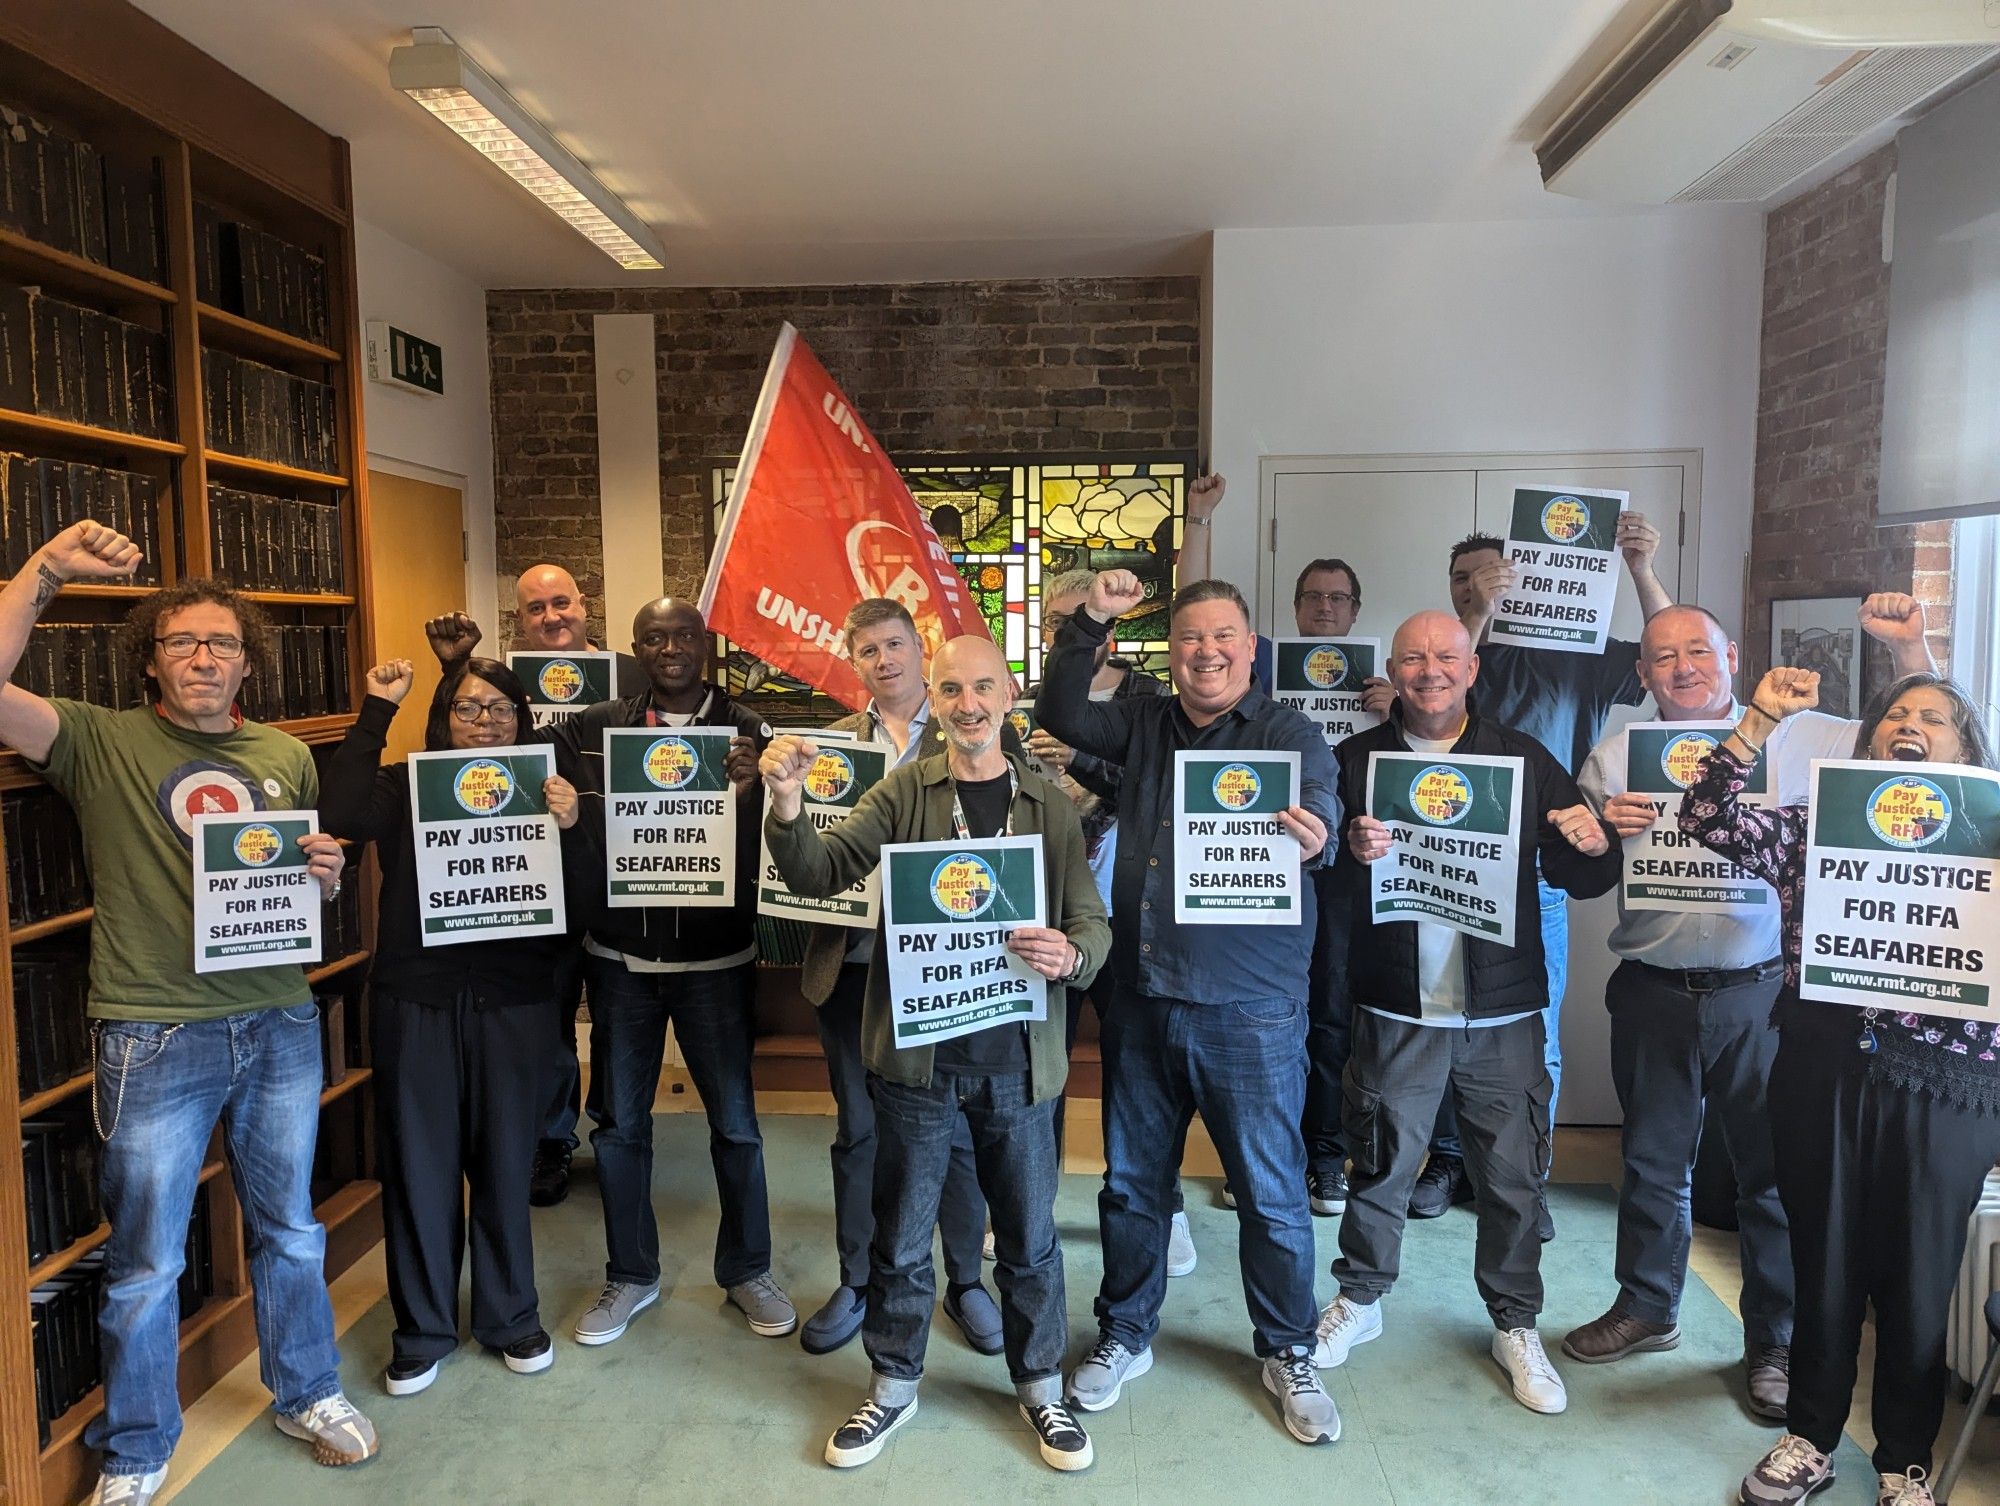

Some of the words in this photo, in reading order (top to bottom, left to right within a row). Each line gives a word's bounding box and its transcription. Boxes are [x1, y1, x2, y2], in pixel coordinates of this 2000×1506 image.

[1557, 504, 1571, 515] Pay
[1546, 513, 1574, 522] Justice
[1555, 527, 1575, 536] RFA
[1512, 549, 1541, 565] PAY
[1545, 553, 1608, 573] JUSTICE
[1522, 576, 1553, 592] FOR
[1557, 580, 1587, 596] RFA
[1501, 599, 1598, 623] SEAFARERS
[1508, 624, 1582, 639] www.rmt.org.uk
[1317, 674, 1333, 682] RFA
[1327, 722, 1354, 734] RFA
[660, 748, 677, 758] Pay
[1681, 744, 1699, 754] Pay
[818, 759, 834, 769] Pay
[1668, 754, 1698, 763] Justic
[472, 771, 489, 781] Pay
[1030, 765, 1042, 773] FA
[660, 772, 681, 781] RFA
[1228, 773, 1242, 781] Pay
[1430, 776, 1448, 788] Pay
[460, 781, 495, 790] Justice
[815, 784, 836, 795] RFA
[1415, 787, 1452, 798] Justice
[473, 796, 497, 807] RFA
[1228, 795, 1246, 804] RFA
[1894, 790, 1918, 804] Pay
[616, 801, 647, 816] PAY
[654, 800, 724, 815] JUSTICE
[1428, 805, 1450, 817] RFA
[1874, 803, 1924, 815] Justice
[1189, 821, 1216, 835] PAY
[1222, 821, 1285, 835] JUSTICE
[1891, 824, 1924, 838] RFA
[426, 829, 461, 848] PAY
[468, 824, 545, 844] JUSTICE
[634, 828, 667, 843] FOR
[674, 828, 706, 843] RFA
[1652, 831, 1691, 847] FOR
[1386, 828, 1413, 843] AY
[1419, 835, 1502, 861] JUSTICE
[250, 852, 268, 861] RFA
[1205, 847, 1234, 861] FOR
[1241, 848, 1270, 861] RFA
[448, 858, 485, 877] FOR
[493, 855, 528, 872] RFA
[616, 856, 720, 872] SEAFARERS
[1399, 853, 1434, 874] FOR
[1442, 864, 1478, 885] RFA
[950, 867, 969, 878] Pay
[1819, 858, 1869, 882] PAY
[1877, 863, 1991, 892] JUSTICE
[209, 878, 238, 892] PAY
[244, 873, 307, 889] JUSTICE
[628, 882, 708, 893] www.rmt.org.uk
[937, 878, 975, 889] Justice
[1189, 873, 1286, 888] SEAFARERS
[430, 884, 546, 908] SEAFARERS
[1381, 878, 1496, 914] SEAFARERS
[1646, 886, 1746, 900] www.rmt.org.uk
[226, 900, 256, 914] FOR
[263, 897, 291, 910] RFA
[775, 893, 852, 912] www.rmt.org.uk
[952, 897, 976, 909] RFA
[1200, 897, 1276, 908] www.rmt.org.uk
[444, 912, 535, 928] www.rmt.org.uk
[1393, 900, 1483, 928] www.rmt.org.uk
[1844, 898, 1895, 923] FOR
[1906, 904, 1960, 929] RFA
[210, 918, 307, 939] SEAFARERS
[221, 939, 297, 954] www.rmt.org.uk
[899, 933, 937, 952] PAY
[1815, 934, 1984, 972] SEAFARERS
[922, 965, 962, 983] FOR
[970, 955, 1008, 976] RFA
[1831, 971, 1961, 998] www.rmt.org.uk
[903, 979, 1028, 1015] SEAFARERS
[918, 1002, 1014, 1032] www.rmt.org.uk
